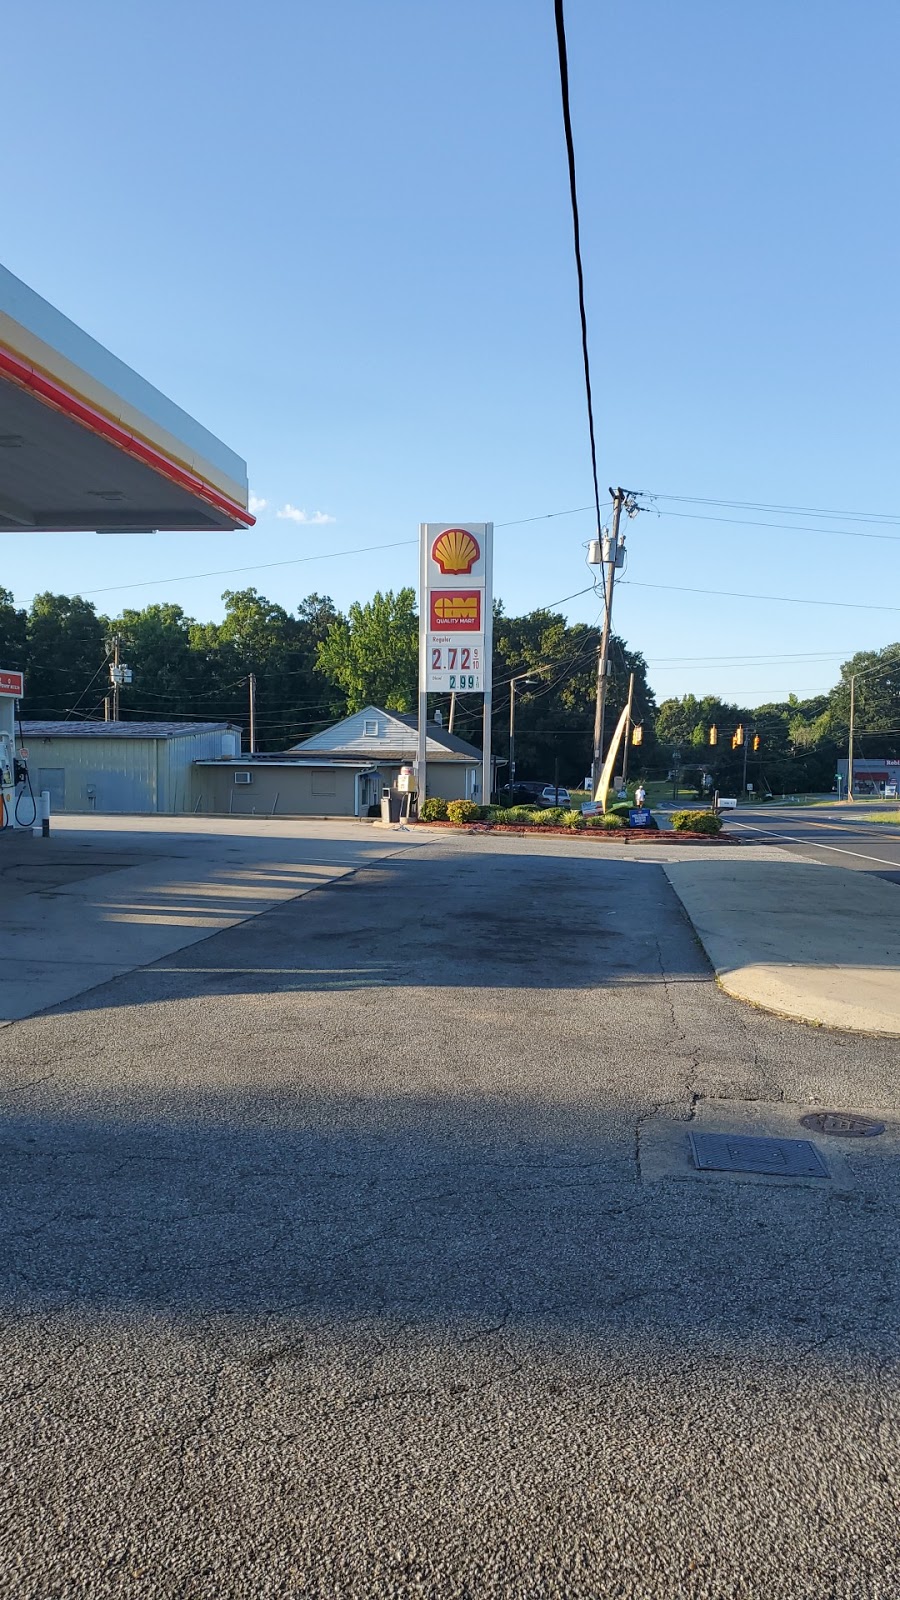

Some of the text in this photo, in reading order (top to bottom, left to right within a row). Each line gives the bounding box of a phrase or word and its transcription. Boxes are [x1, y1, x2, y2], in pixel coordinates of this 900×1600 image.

[432, 648, 470, 670] 2.72
[473, 661, 479, 669] 10
[449, 676, 474, 688] 2.99
